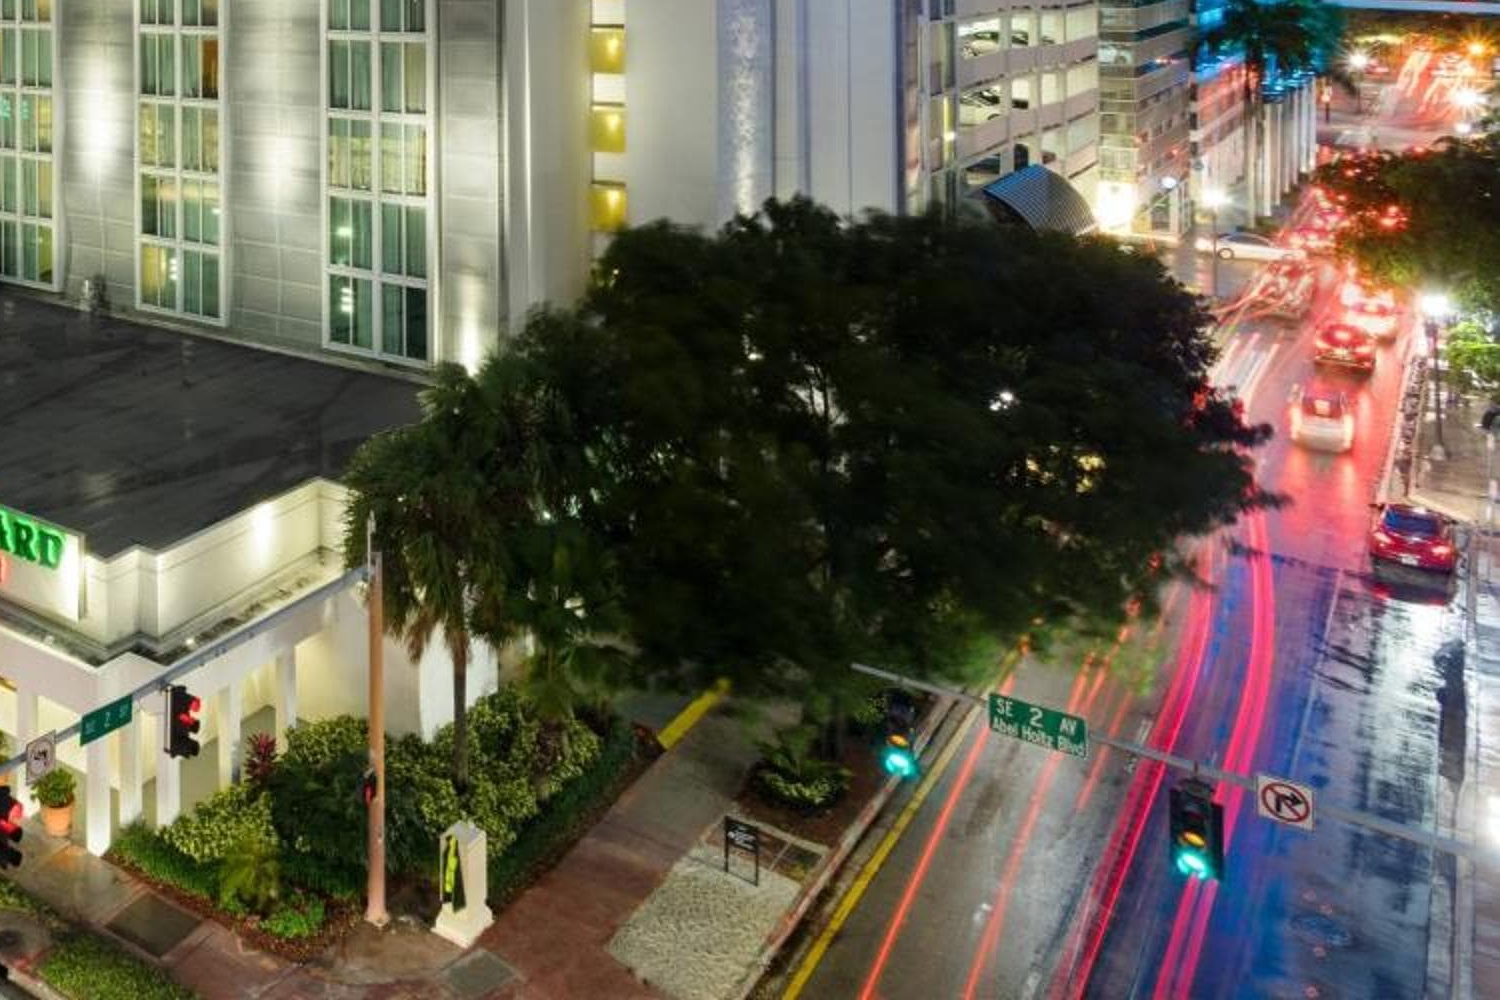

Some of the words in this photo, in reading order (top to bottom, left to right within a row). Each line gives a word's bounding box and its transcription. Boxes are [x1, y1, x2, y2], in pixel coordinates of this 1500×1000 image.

[996, 697, 1013, 717] SE
[1029, 707, 1044, 728] 2
[1059, 717, 1077, 736] AV
[992, 716, 1019, 737] Abel
[1021, 724, 1054, 748] Holtz
[1057, 735, 1086, 758] Blvd
